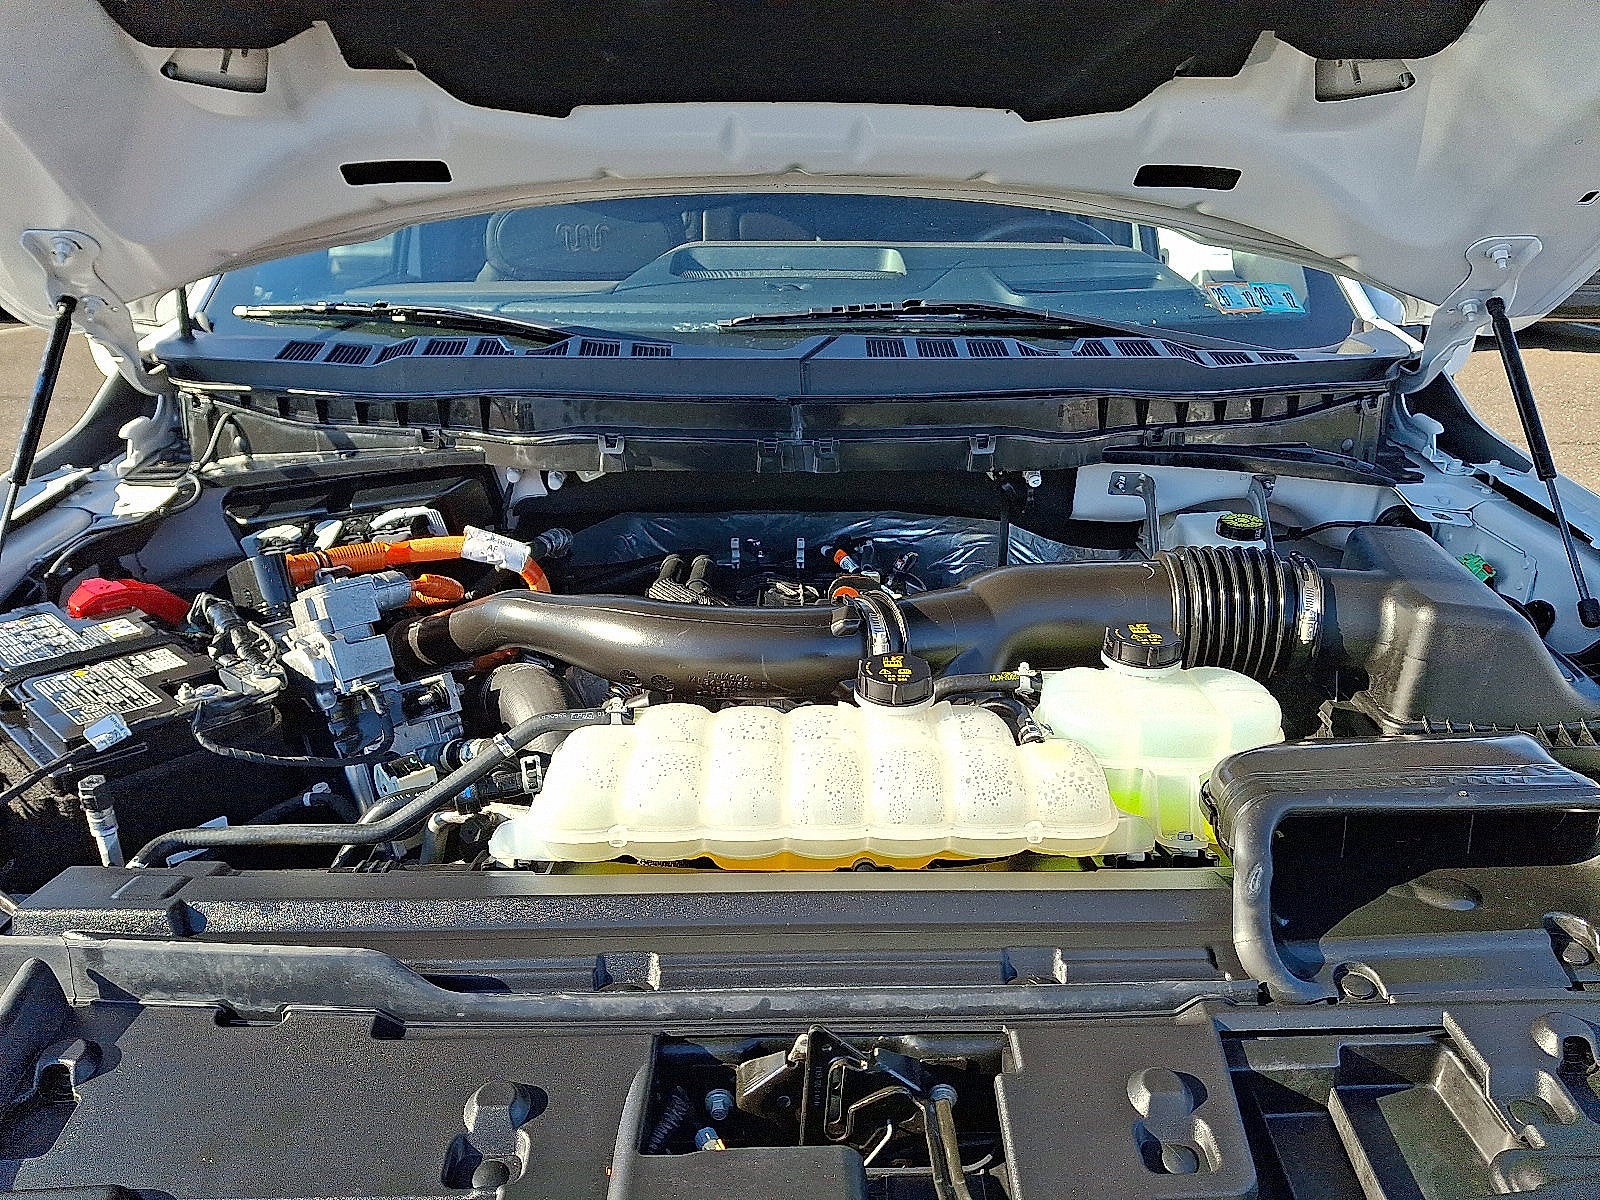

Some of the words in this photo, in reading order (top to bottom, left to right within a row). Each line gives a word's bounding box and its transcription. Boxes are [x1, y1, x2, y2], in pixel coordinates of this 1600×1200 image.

[1211, 287, 1232, 307] 26
[1241, 290, 1259, 308] 12
[1254, 286, 1273, 306] 26
[1282, 292, 1301, 308] 12
